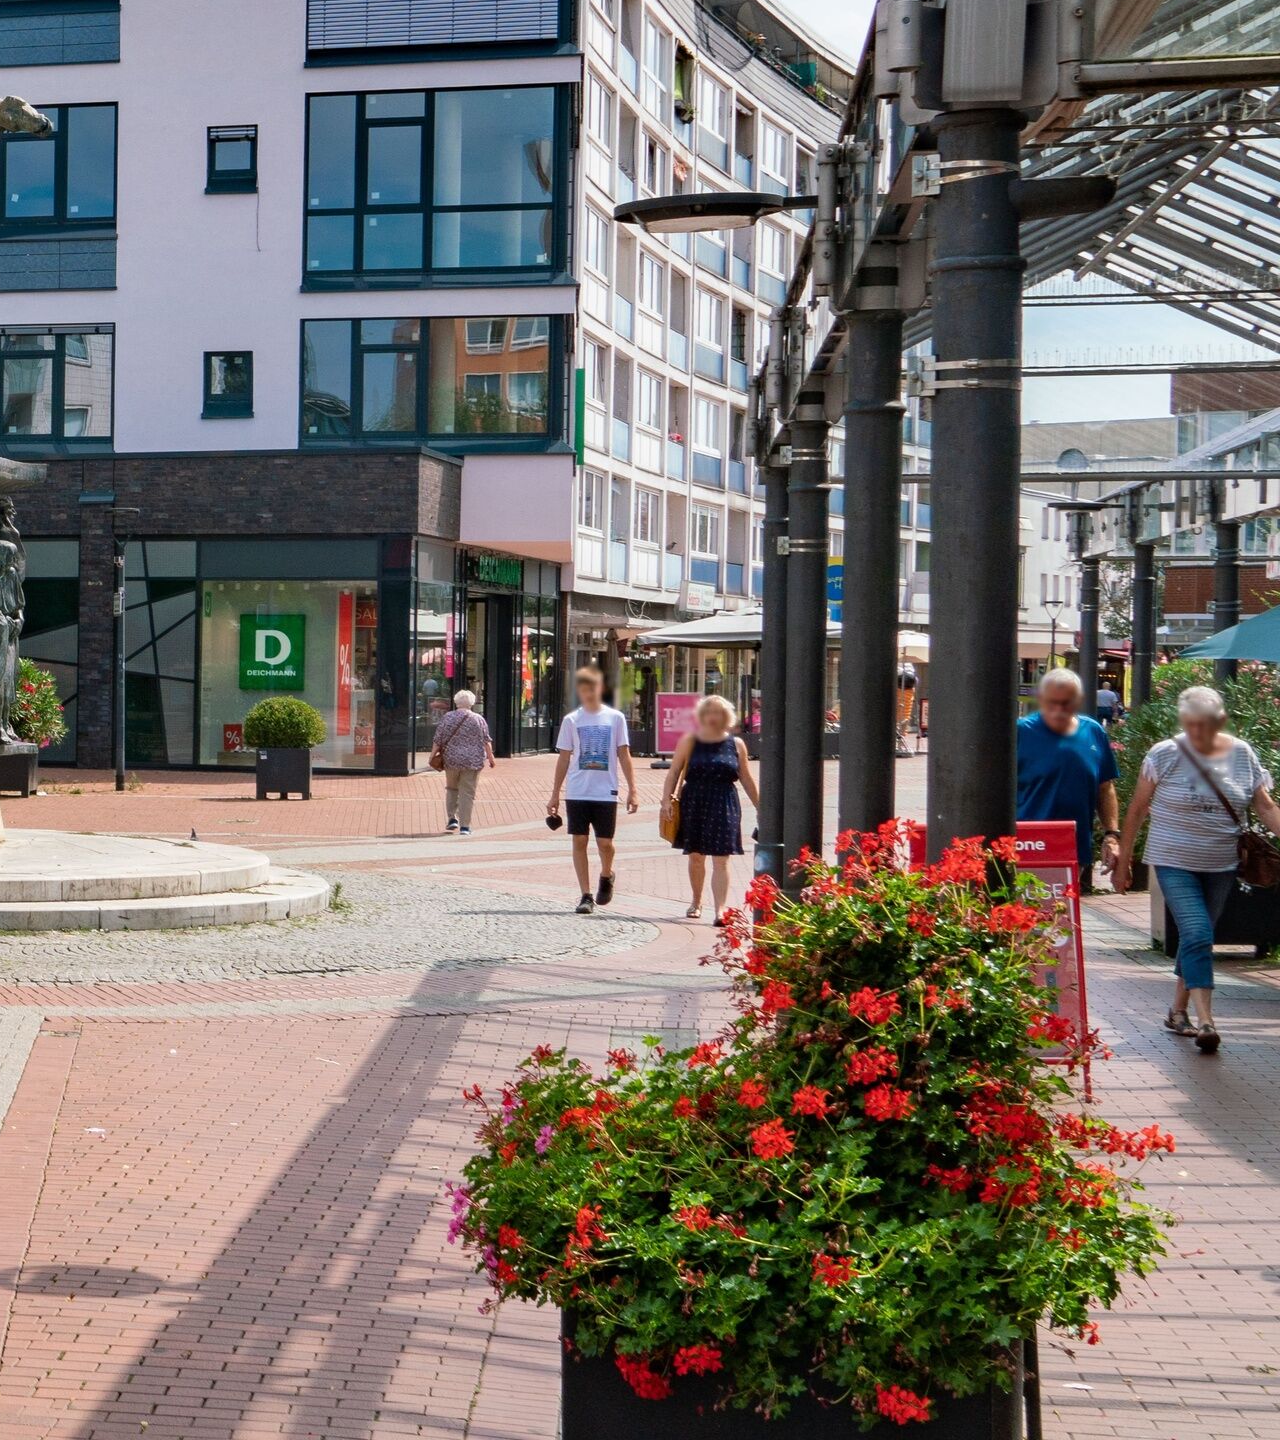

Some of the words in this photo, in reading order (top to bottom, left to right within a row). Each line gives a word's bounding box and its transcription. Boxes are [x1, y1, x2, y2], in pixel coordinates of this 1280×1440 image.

[355, 607, 377, 620] SAL
[255, 629, 292, 666] D
[246, 669, 296, 677] DEICHMANN
[1014, 840, 1046, 851] one
